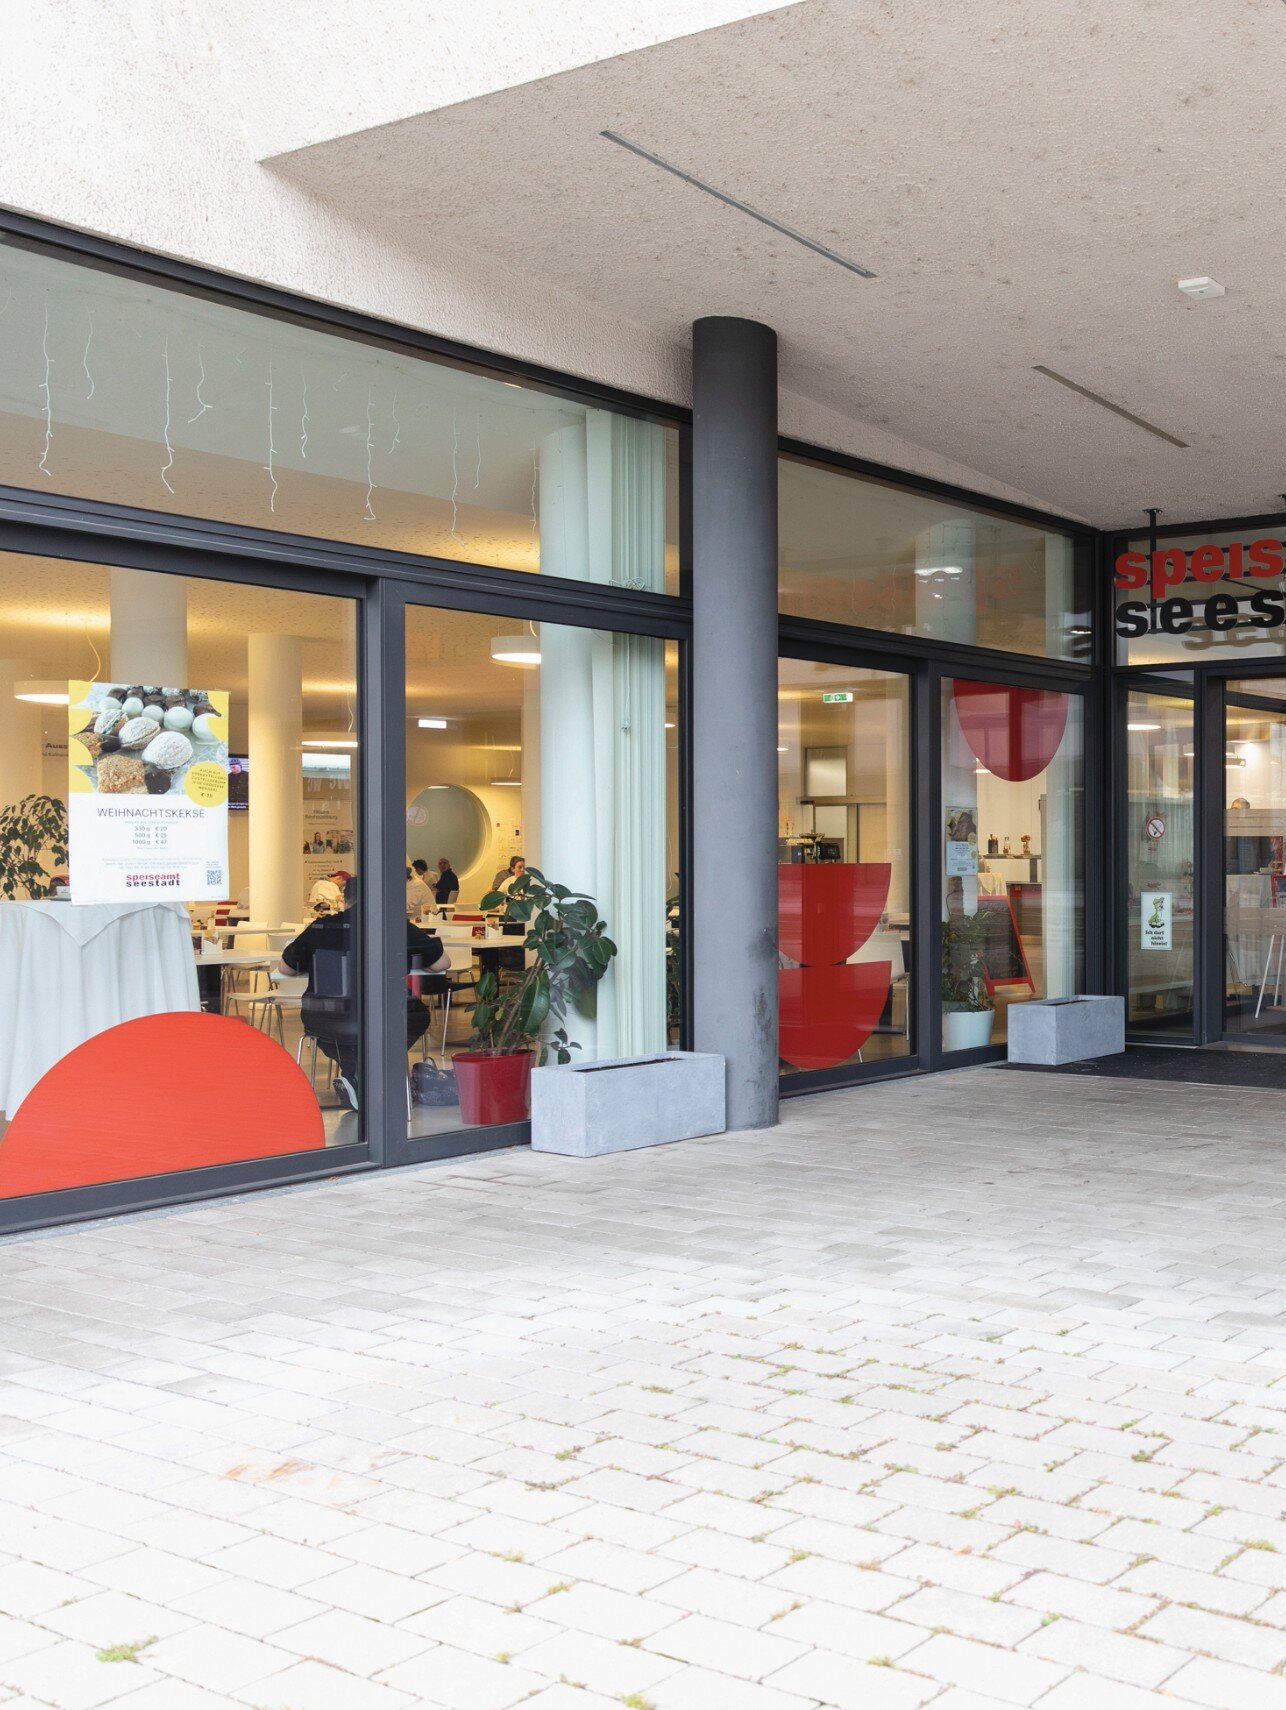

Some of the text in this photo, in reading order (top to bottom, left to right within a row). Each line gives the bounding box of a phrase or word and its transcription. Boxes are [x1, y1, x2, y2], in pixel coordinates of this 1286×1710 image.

[97, 808, 205, 819] WEIHNACHTSKEKSE
[126, 873, 180, 881] speiseamt
[126, 879, 180, 887] seestadt
